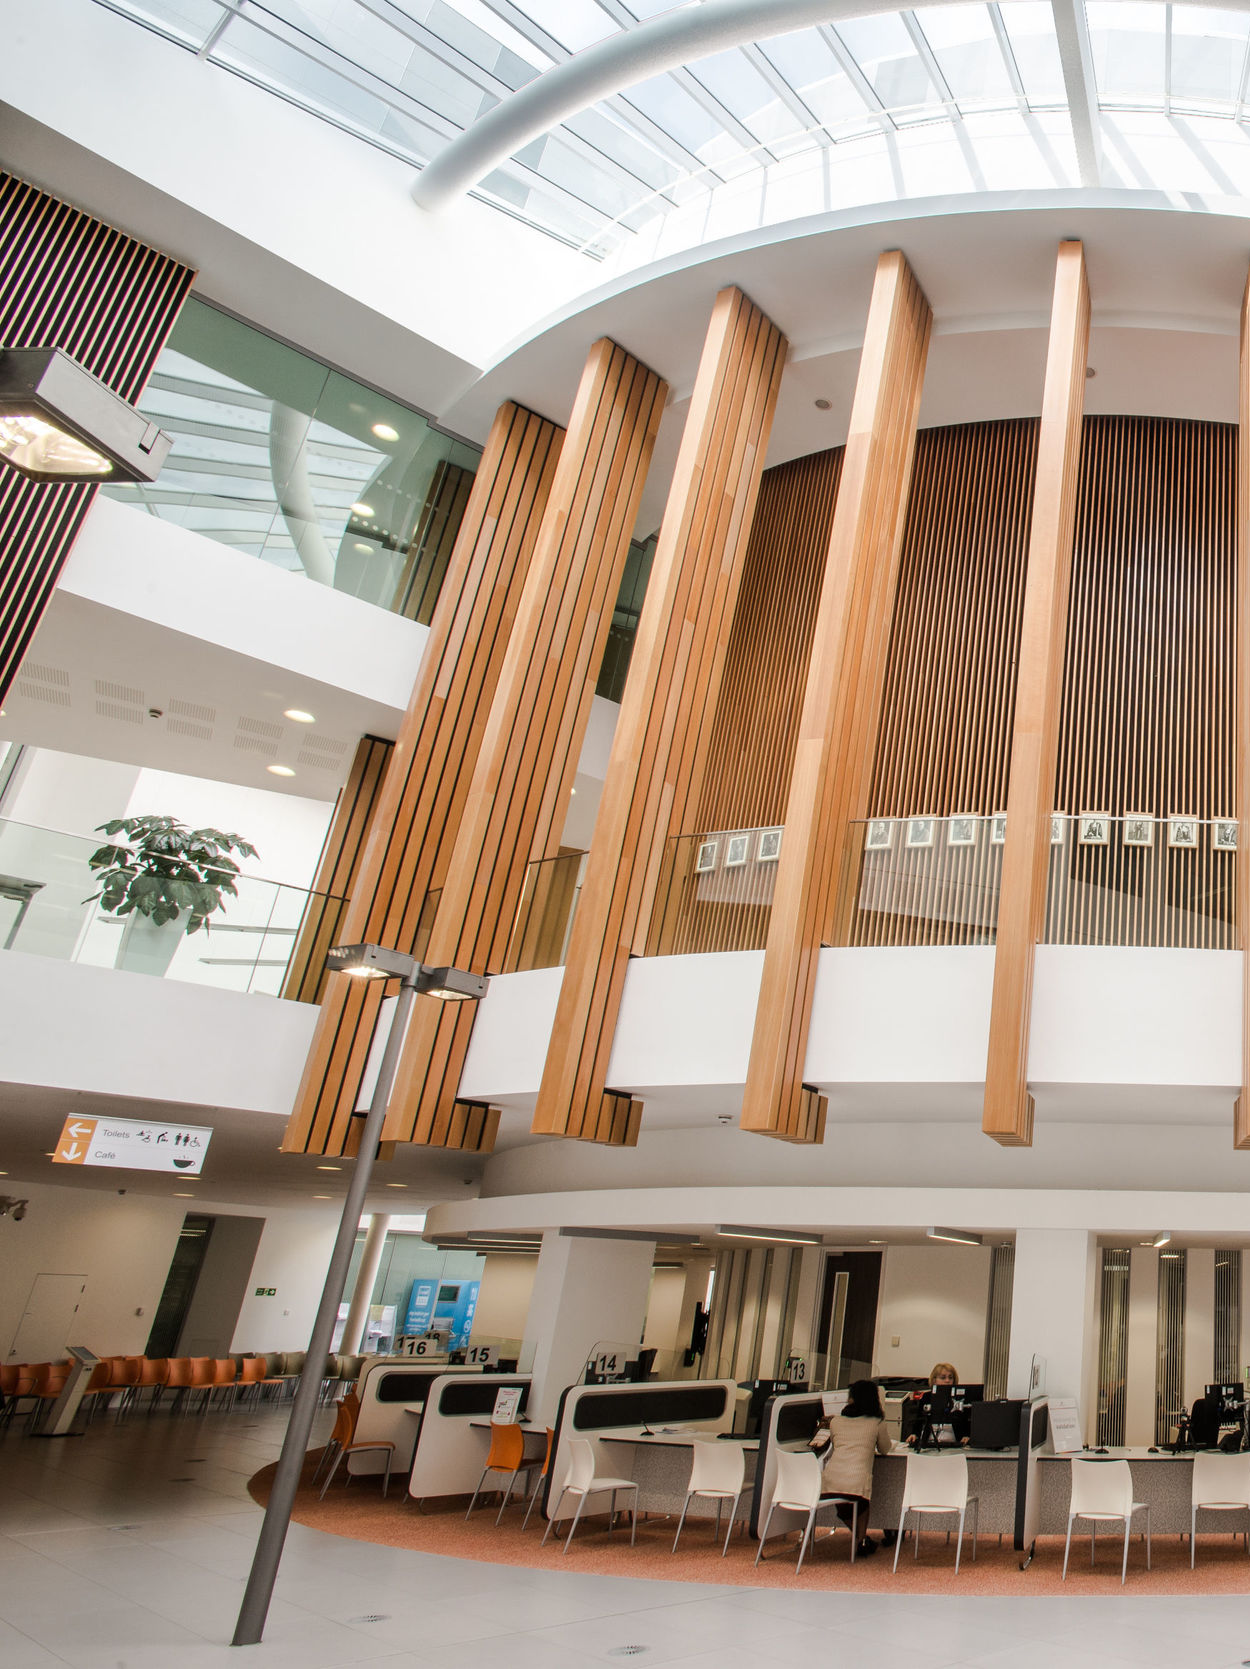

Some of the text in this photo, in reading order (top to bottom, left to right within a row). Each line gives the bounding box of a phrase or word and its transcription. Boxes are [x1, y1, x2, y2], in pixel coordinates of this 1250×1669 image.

[103, 1129, 130, 1139] Toilets
[94, 1151, 116, 1160] Café
[407, 1341, 427, 1355] 16
[470, 1347, 490, 1363] 15
[600, 1355, 617, 1371] 14
[794, 1363, 805, 1380] 13
